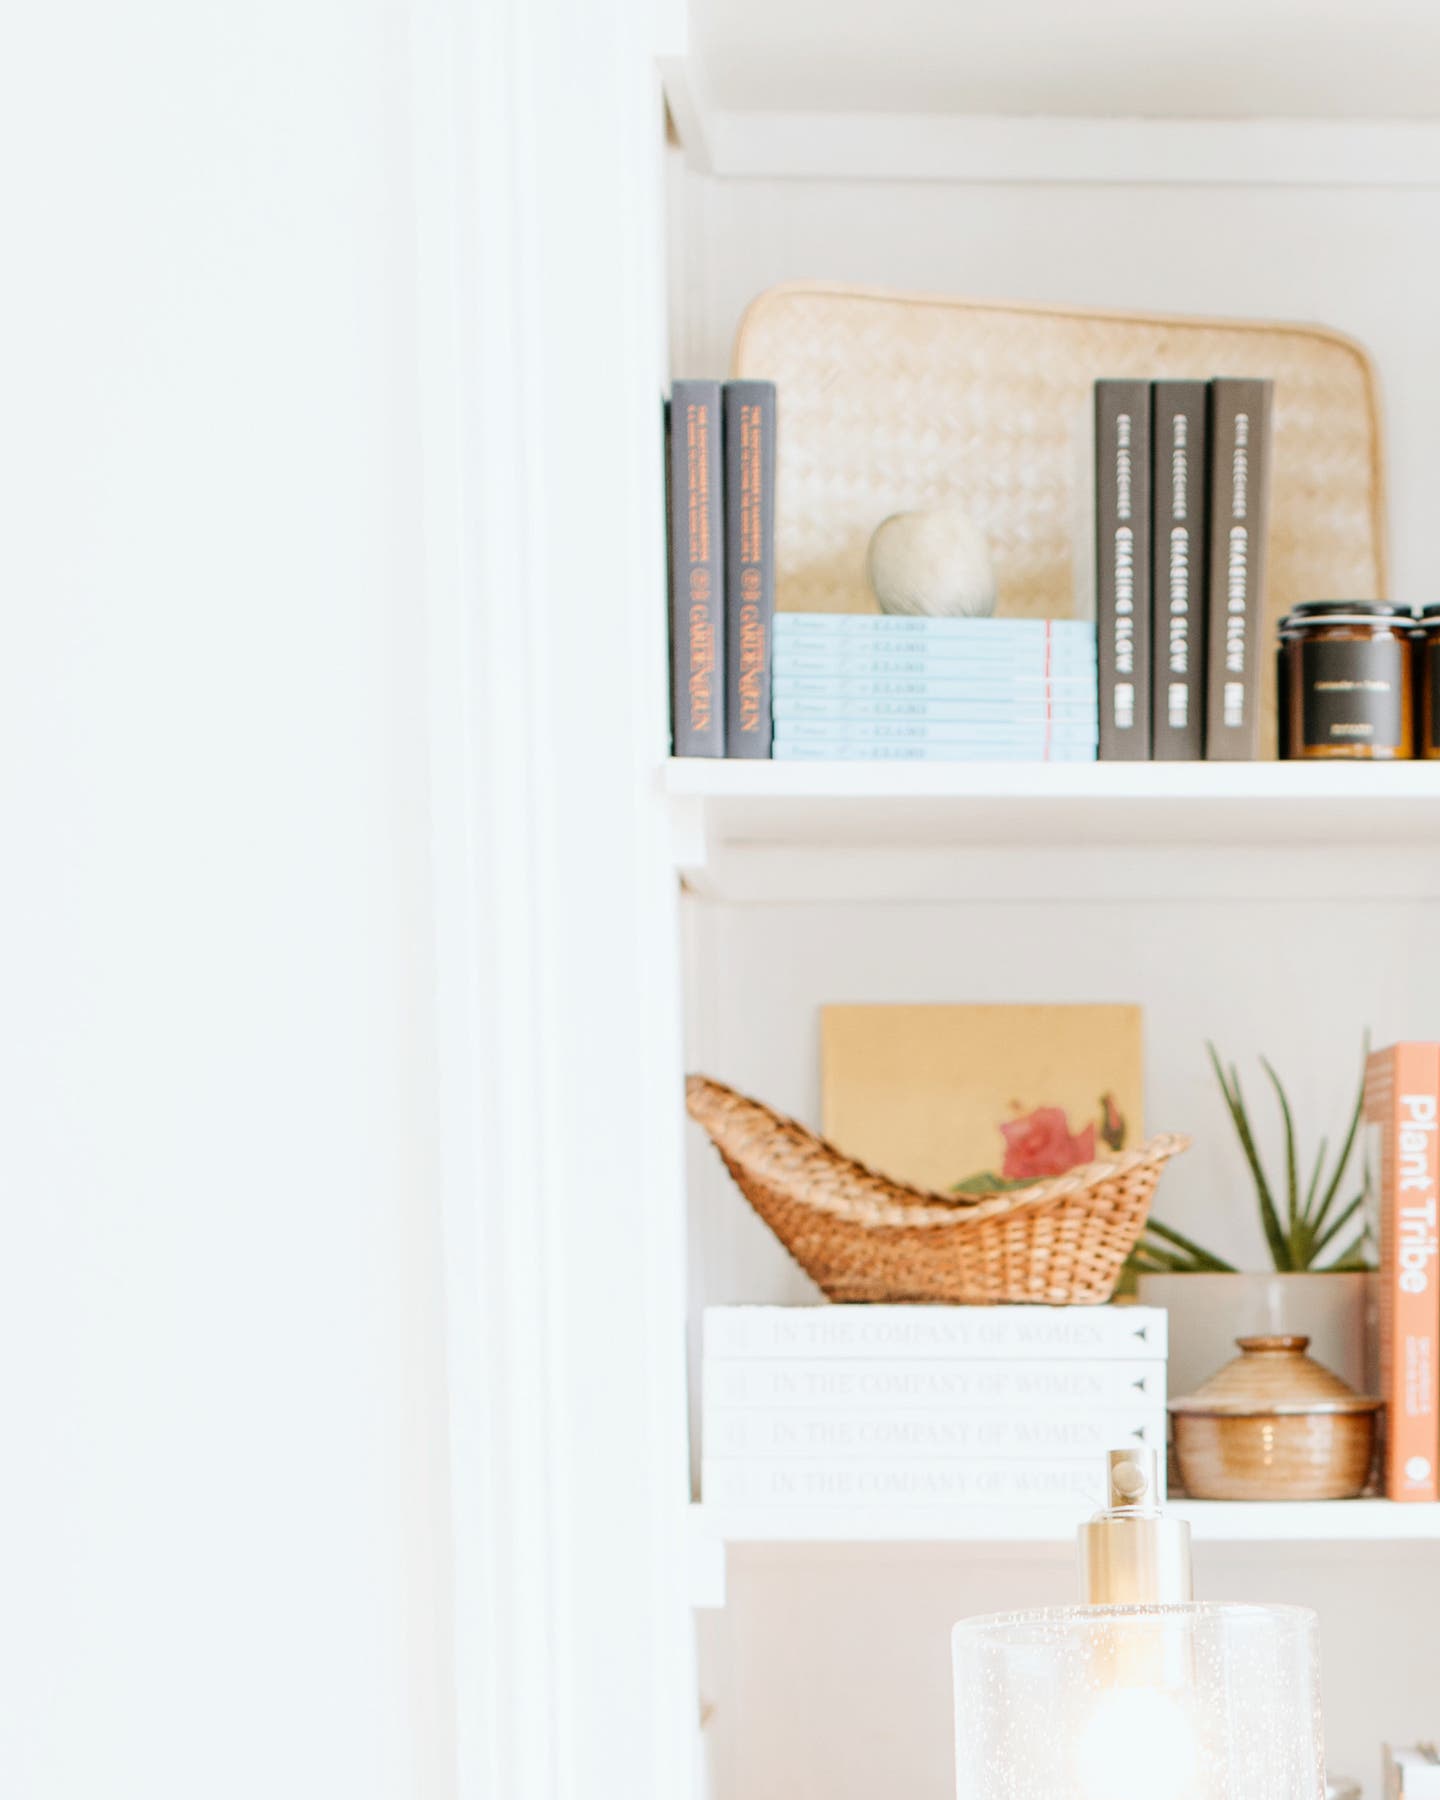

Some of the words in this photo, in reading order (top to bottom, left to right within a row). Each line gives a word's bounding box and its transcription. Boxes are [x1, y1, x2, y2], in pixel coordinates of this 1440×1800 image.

[1115, 527, 1134, 613] CHASING
[1169, 527, 1189, 613] CHASING
[1227, 526, 1248, 612] CHASING
[1115, 617, 1134, 673] SLOW
[1169, 617, 1189, 673] SLOW
[1226, 617, 1246, 673] SLOW
[1399, 1094, 1438, 1190] Plant
[1399, 1198, 1438, 1293] Tribe
[801, 1320, 852, 1344] THE
[858, 1320, 969, 1344] COMPANY
[1014, 1320, 1103, 1344] WOMEN
[801, 1372, 852, 1394] THE
[858, 1372, 969, 1394] COMPANY
[1014, 1372, 1103, 1394] WOMEN
[801, 1423, 852, 1445] THE
[858, 1423, 969, 1445] COMPANY
[1014, 1423, 1103, 1445] WOMEN
[801, 1472, 852, 1494] THE
[858, 1472, 969, 1494] COMPANY
[1014, 1472, 1103, 1494] WOMEN
